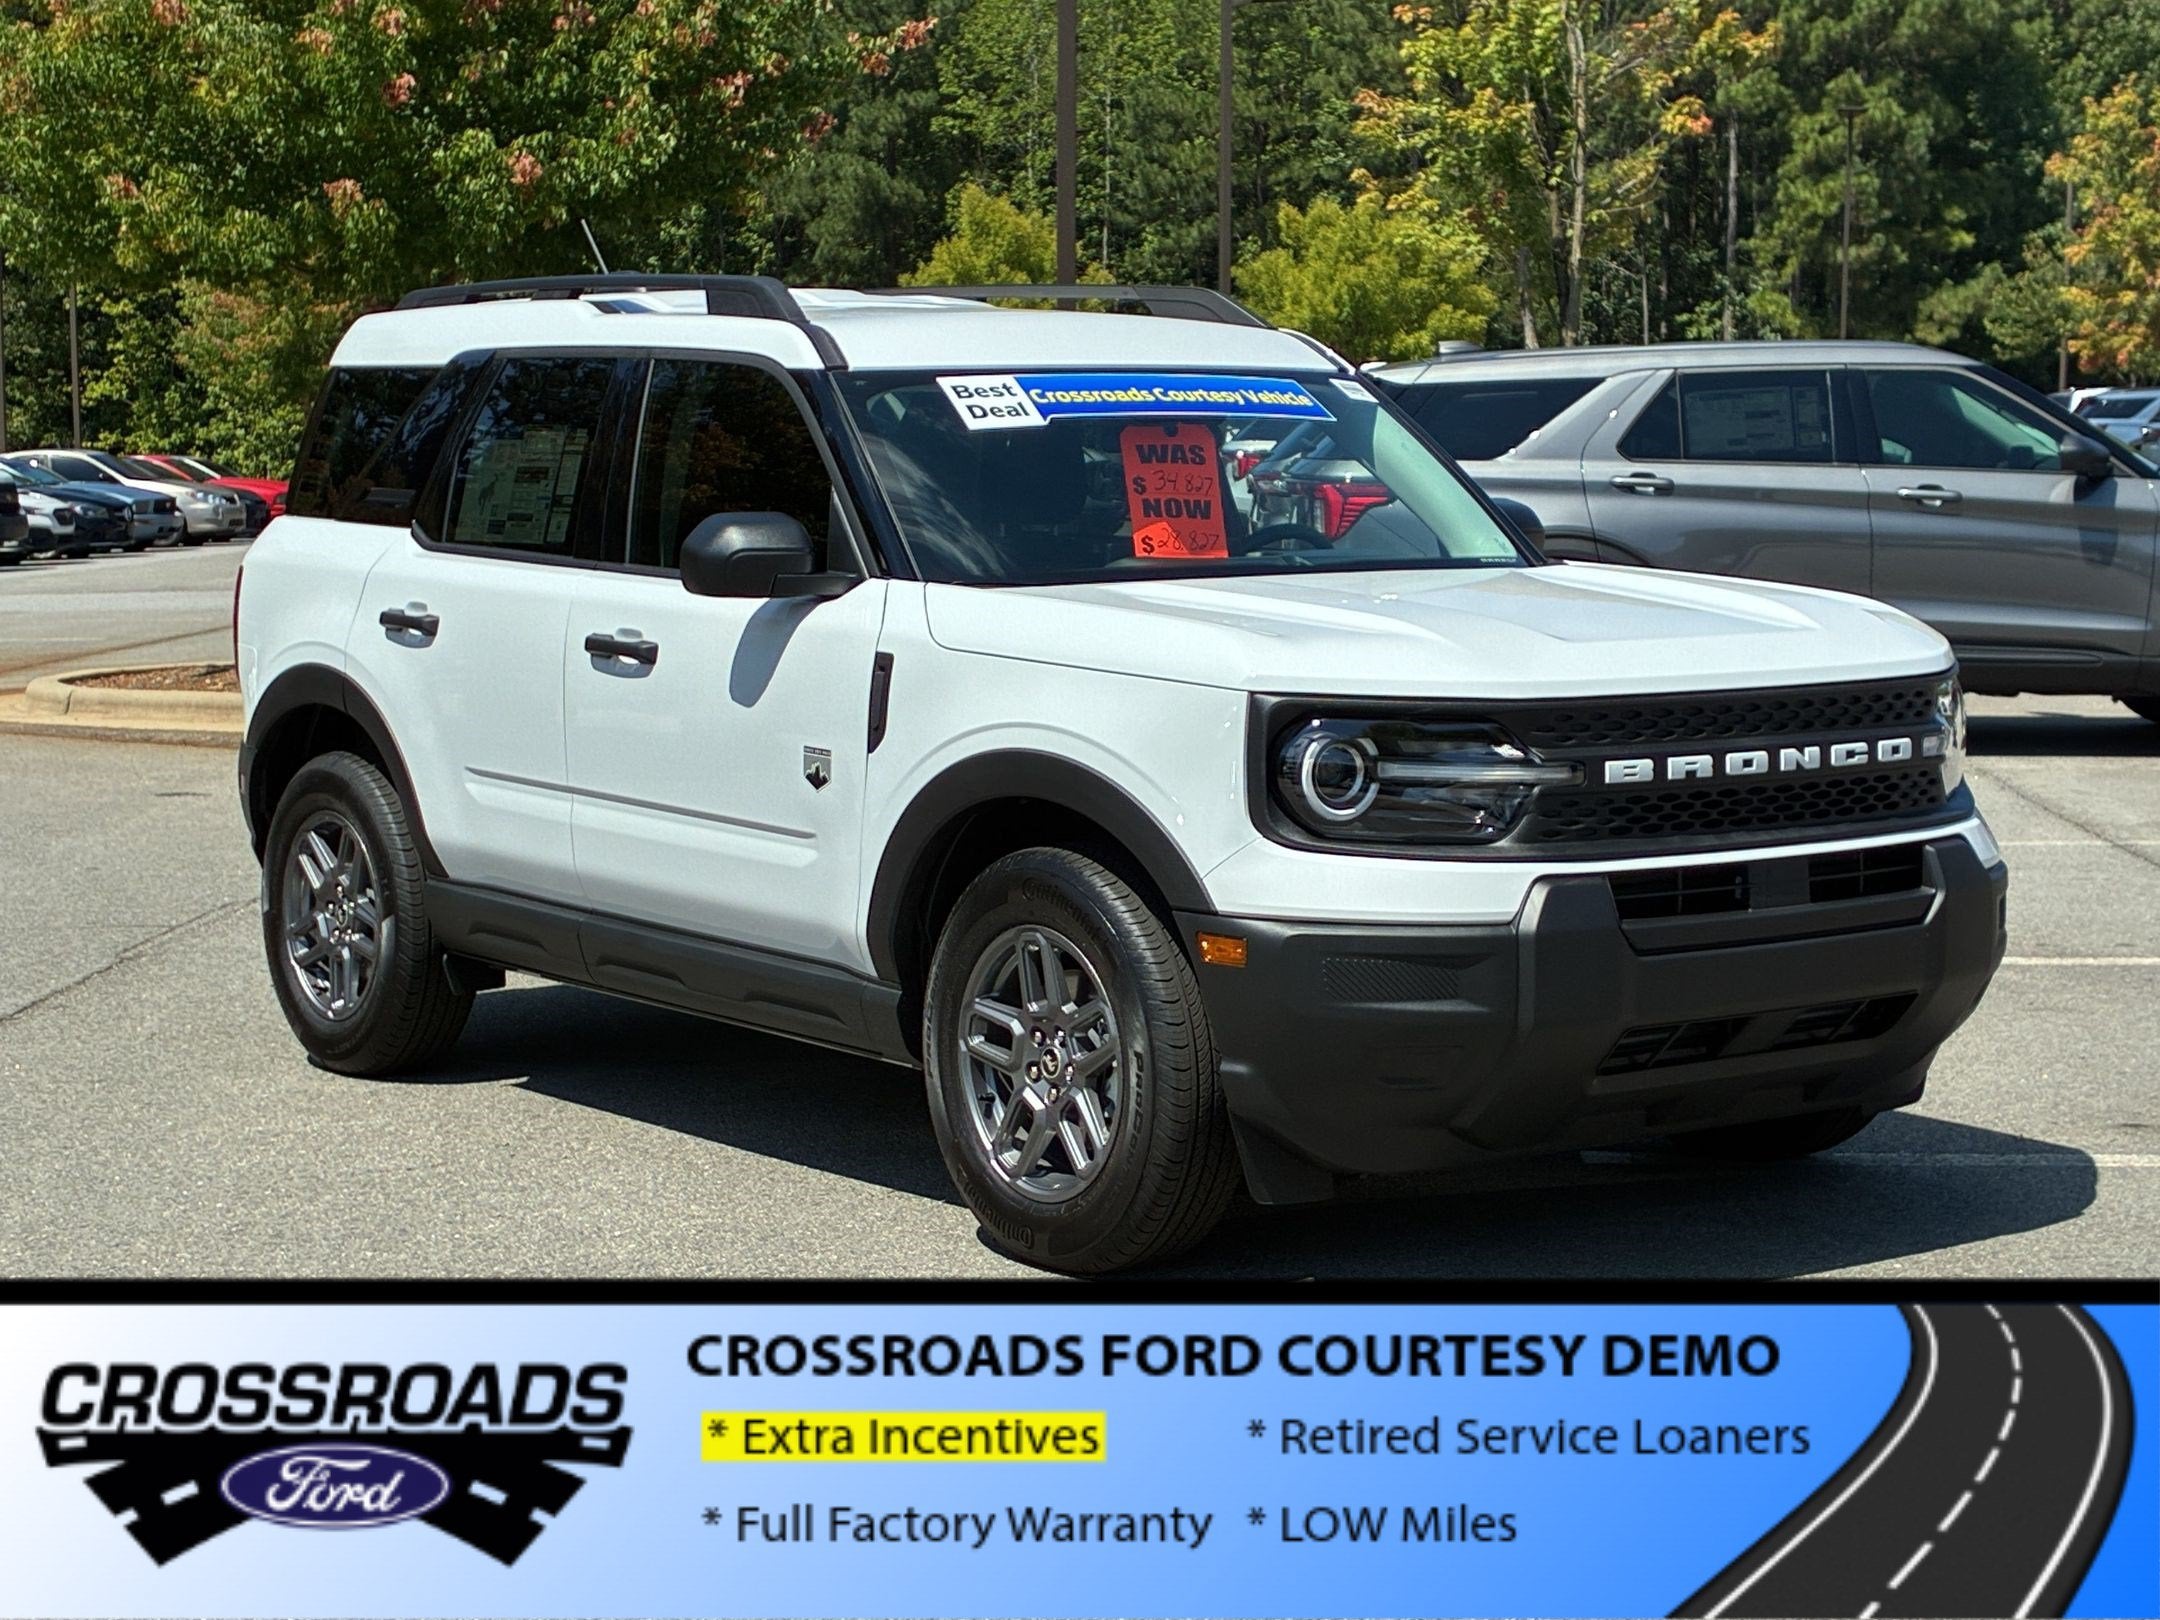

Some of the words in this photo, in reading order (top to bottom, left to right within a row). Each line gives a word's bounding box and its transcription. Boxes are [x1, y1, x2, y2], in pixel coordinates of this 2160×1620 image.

[951, 382, 1018, 399] Best
[1028, 386, 1154, 404] Crossroads
[1151, 387, 1246, 406] Courtesy
[1242, 389, 1314, 406] Vehicle
[966, 402, 1030, 419] Deal
[1135, 443, 1207, 466] WAS
[1142, 498, 1212, 520] NOW
[1604, 737, 1912, 784] BRONCO
